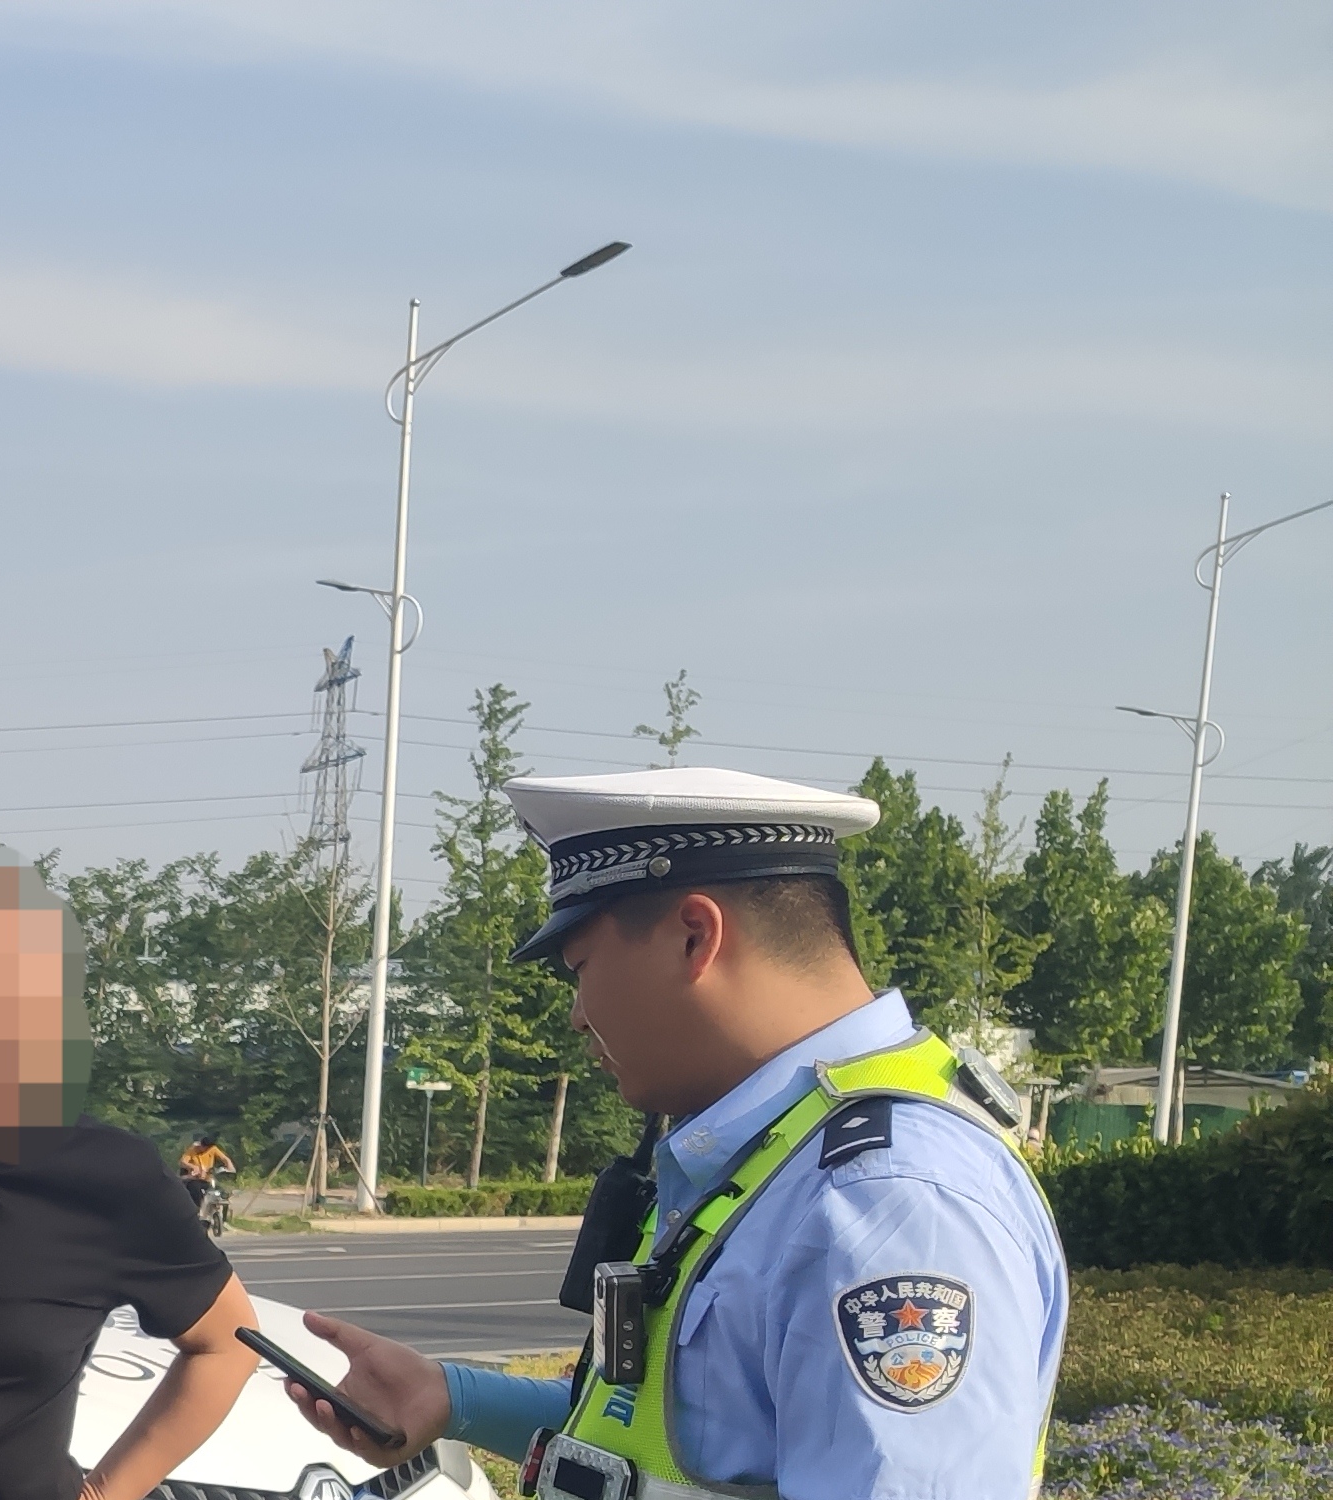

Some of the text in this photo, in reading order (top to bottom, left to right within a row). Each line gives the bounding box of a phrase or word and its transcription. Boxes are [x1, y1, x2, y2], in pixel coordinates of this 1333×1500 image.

[844, 1282, 967, 1314] 中华人民共和国
[857, 1307, 960, 1338] 警察
[886, 1333, 939, 1348] POLICE
